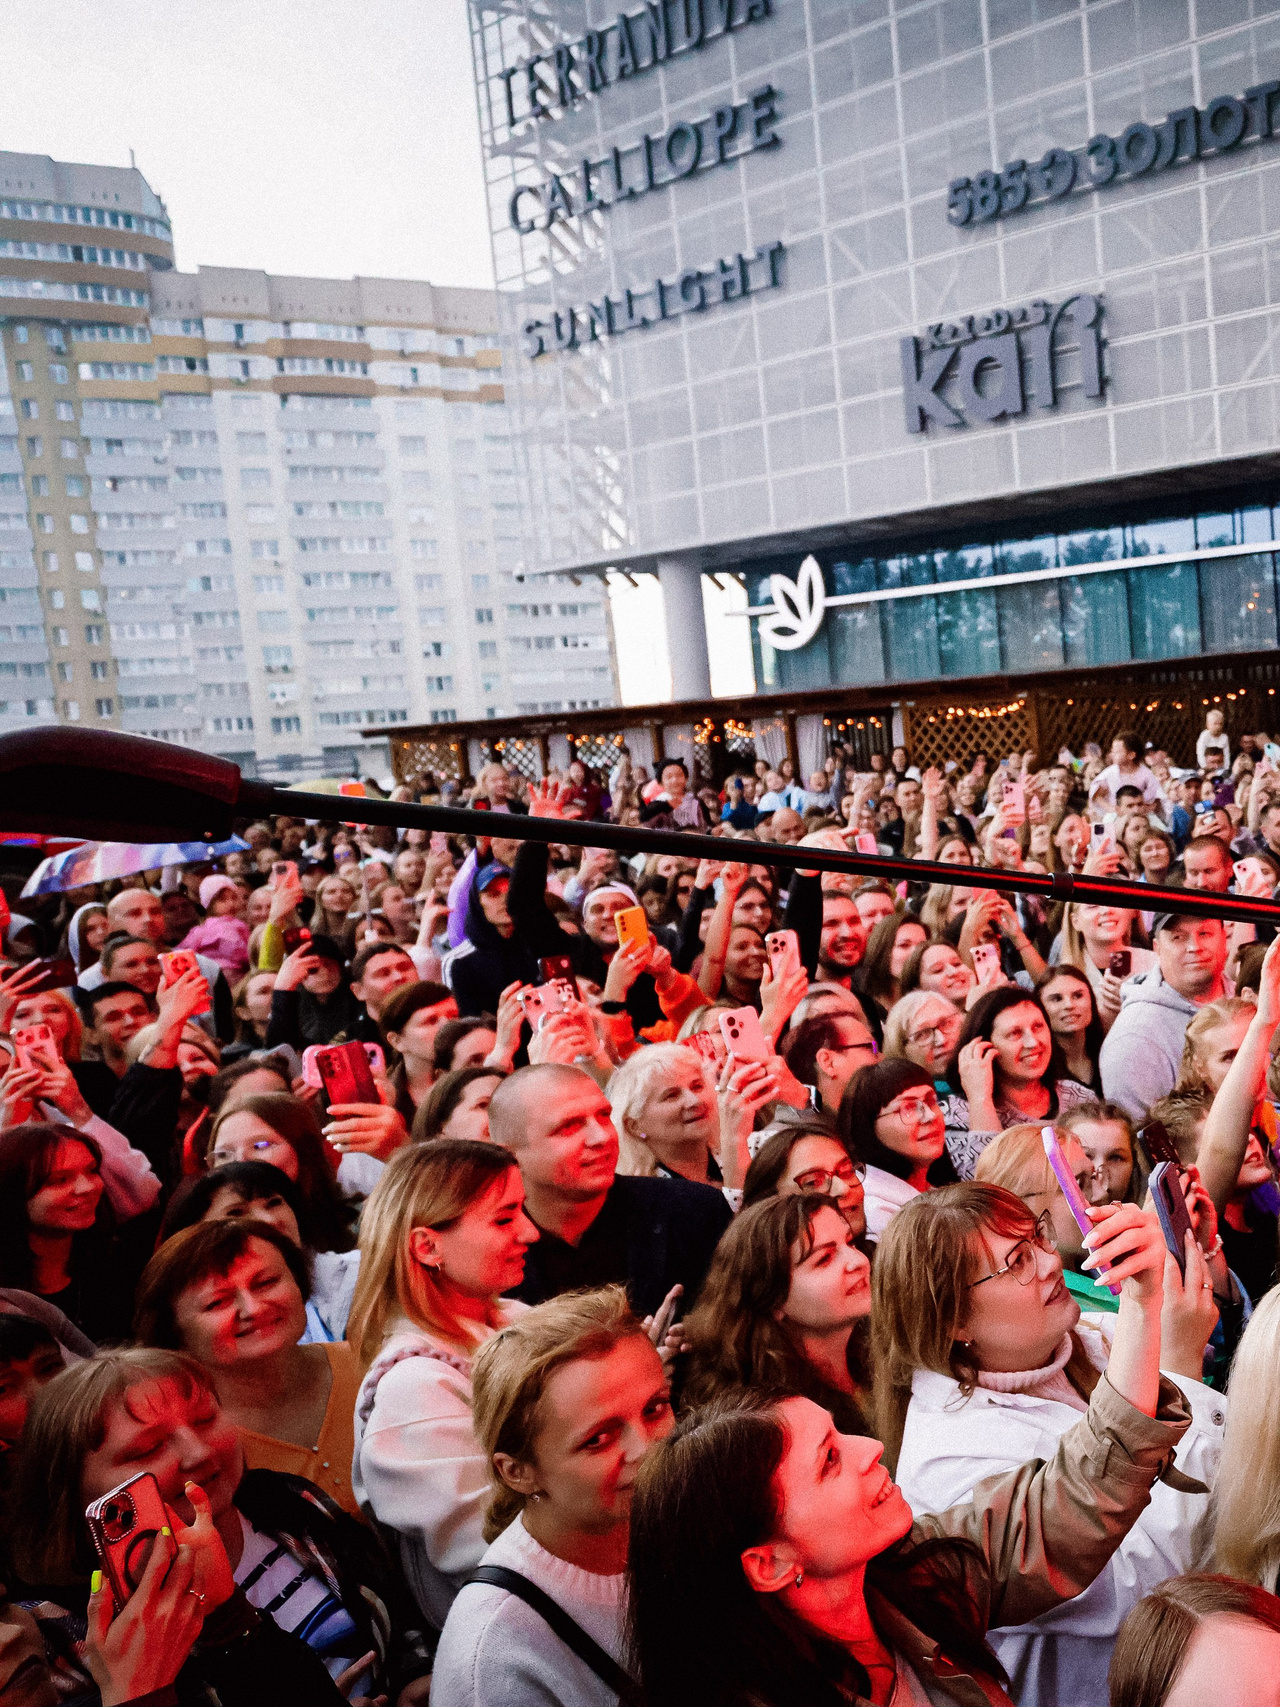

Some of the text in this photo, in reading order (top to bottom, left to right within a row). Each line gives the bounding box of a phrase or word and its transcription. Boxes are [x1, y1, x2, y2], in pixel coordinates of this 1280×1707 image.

[501, 0, 773, 128] TERRANO
[509, 84, 781, 235] CALLIOPE
[946, 160, 1031, 229] 585
[524, 240, 787, 359] SUNLIGHT
